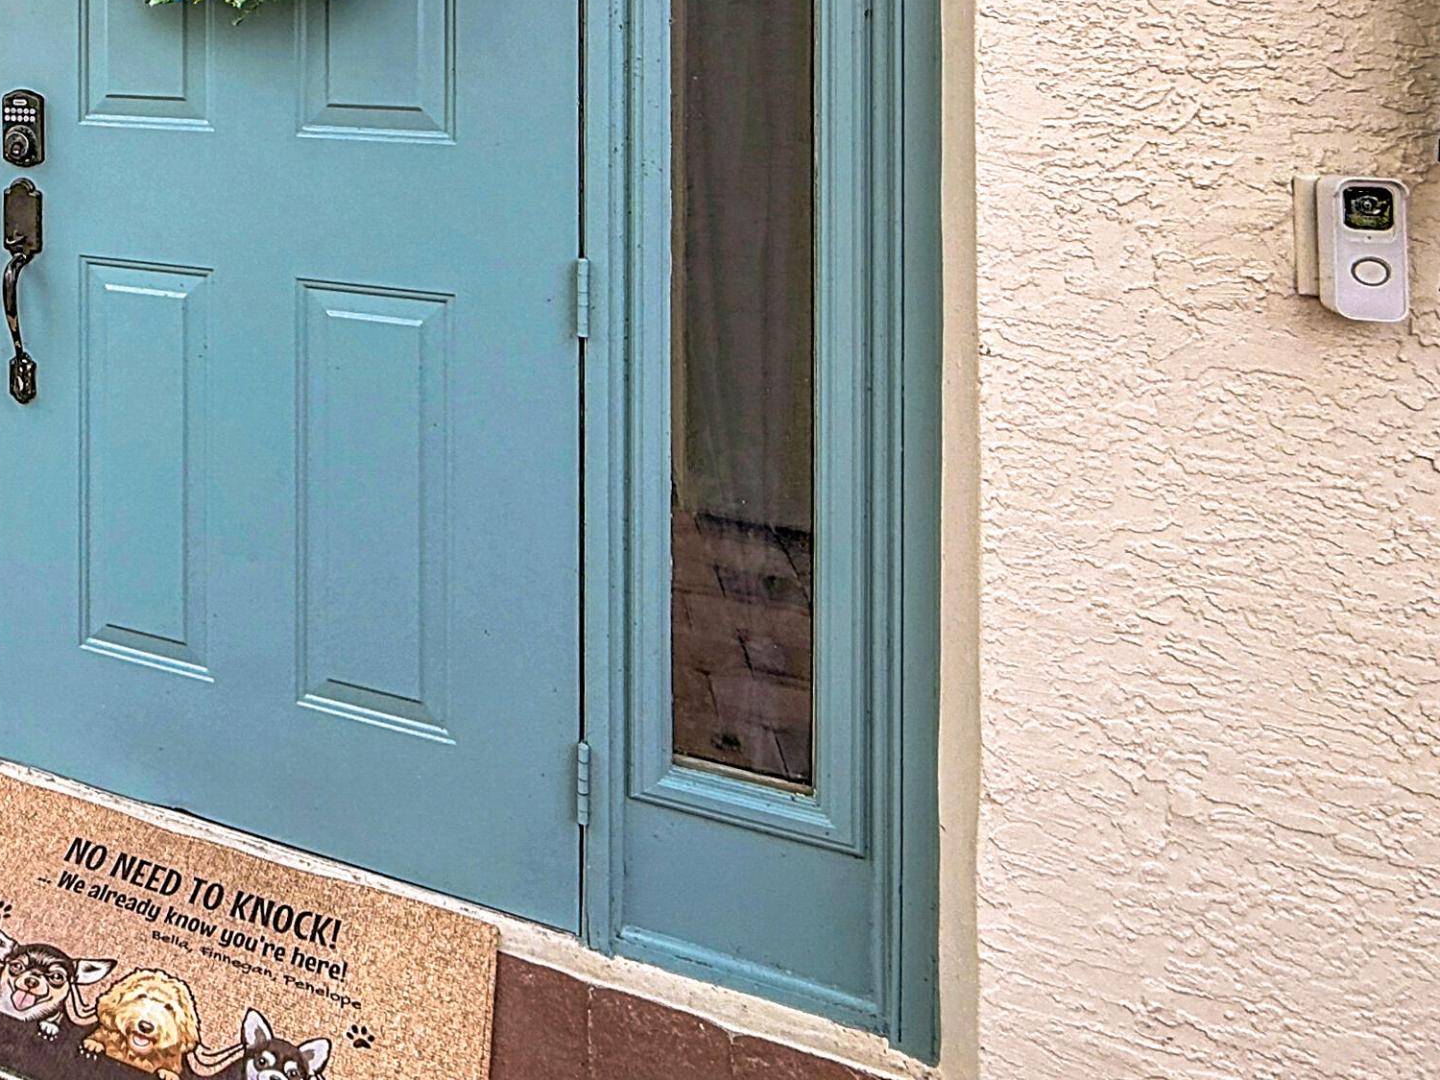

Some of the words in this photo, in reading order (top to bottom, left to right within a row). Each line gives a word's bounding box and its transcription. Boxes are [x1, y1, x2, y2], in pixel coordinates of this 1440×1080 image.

[57, 871, 86, 895] We
[88, 880, 161, 923] already
[164, 906, 217, 939] know
[220, 928, 286, 963] you're
[291, 946, 349, 983] here!
[63, 837, 108, 871] NO
[110, 852, 183, 896] NEED
[188, 875, 225, 911] TO
[229, 890, 343, 951] KNOCK!
[151, 930, 193, 954] Bella,
[200, 945, 278, 983] Finnegan,
[283, 974, 362, 1011] Penelope
